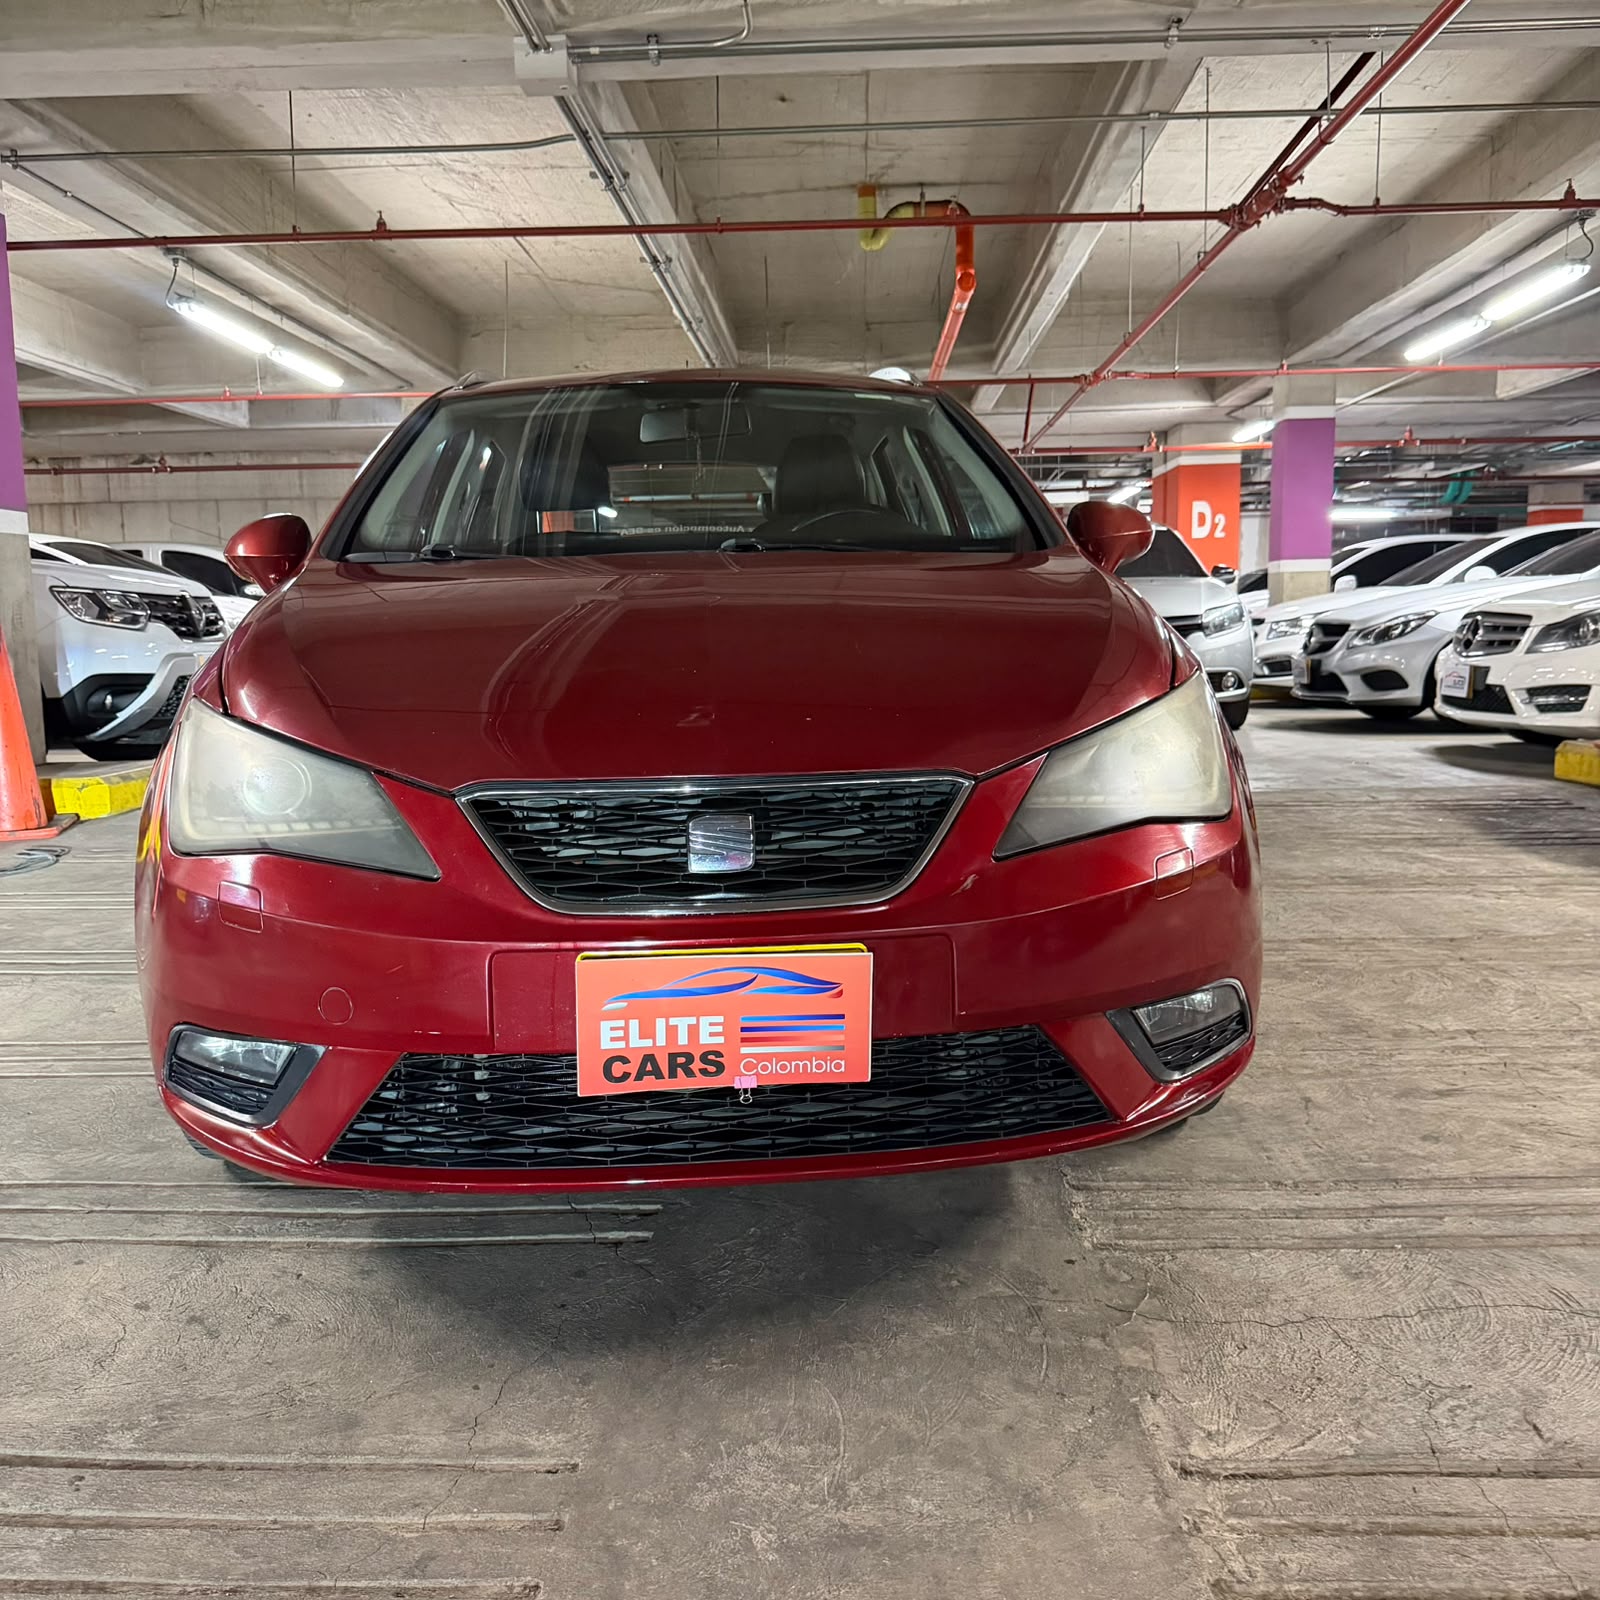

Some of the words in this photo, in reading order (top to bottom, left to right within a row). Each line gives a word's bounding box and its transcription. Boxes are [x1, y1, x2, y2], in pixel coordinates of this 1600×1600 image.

[1191, 500, 1226, 539] D2
[600, 1016, 725, 1049] ELITE
[602, 1050, 726, 1083] CARS
[740, 1056, 846, 1076] Colombia
